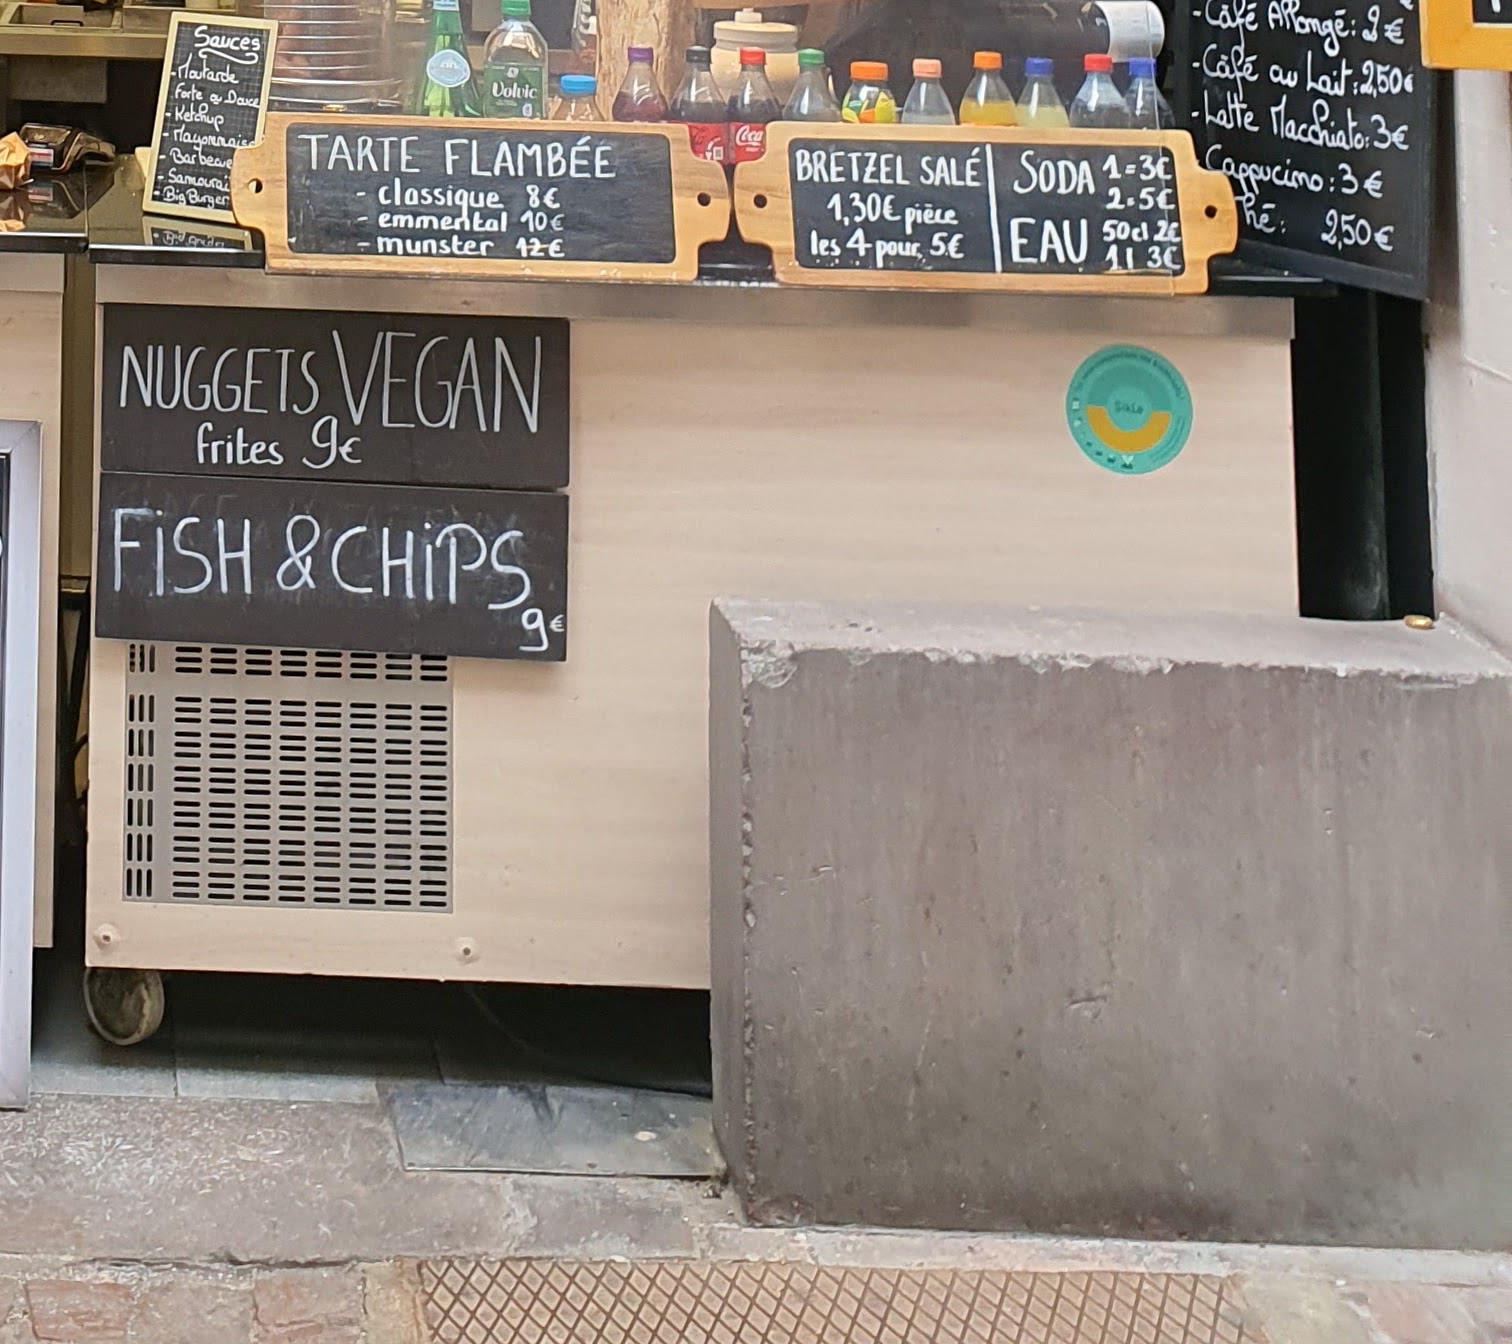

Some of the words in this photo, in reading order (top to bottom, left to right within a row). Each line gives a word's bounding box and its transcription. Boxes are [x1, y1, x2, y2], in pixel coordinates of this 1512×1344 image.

[194, 25, 260, 51] Sauces
[177, 53, 238, 84] Moutarde
[1269, 64, 1298, 88] au
[175, 82, 203, 102] Forte
[225, 90, 259, 108] Douce
[492, 82, 537, 99] Volvic
[175, 104, 224, 132] Ketchup
[1204, 90, 1259, 132] Latte
[298, 134, 420, 173] TARTE
[444, 138, 616, 178] FLAMBÉE
[796, 150, 910, 186] BRETZEL
[919, 148, 981, 187] SALÉ
[1013, 150, 1096, 195] SODA
[163, 187, 186, 205] Big
[188, 187, 230, 209] Burger
[378, 179, 504, 218] classique
[527, 185, 561, 209] 8€
[378, 209, 507, 233] emmental
[520, 213, 563, 233] 10€
[826, 193, 901, 225] 1,30€
[904, 207, 958, 236] pièce
[377, 235, 494, 256] munster
[516, 238, 565, 258] 12€
[810, 231, 841, 257] les
[846, 231, 871, 257] 4
[1011, 218, 1087, 264] EAU
[1103, 220, 1148, 242] 50cl
[1154, 220, 1181, 242] 2€
[1147, 246, 1181, 270] 3€
[119, 346, 320, 414] NUGGETS
[332, 330, 541, 433] VEGAN
[197, 421, 284, 465] frites
[302, 415, 362, 469] 9€
[276, 514, 320, 591] &
[519, 607, 564, 652] 9€
